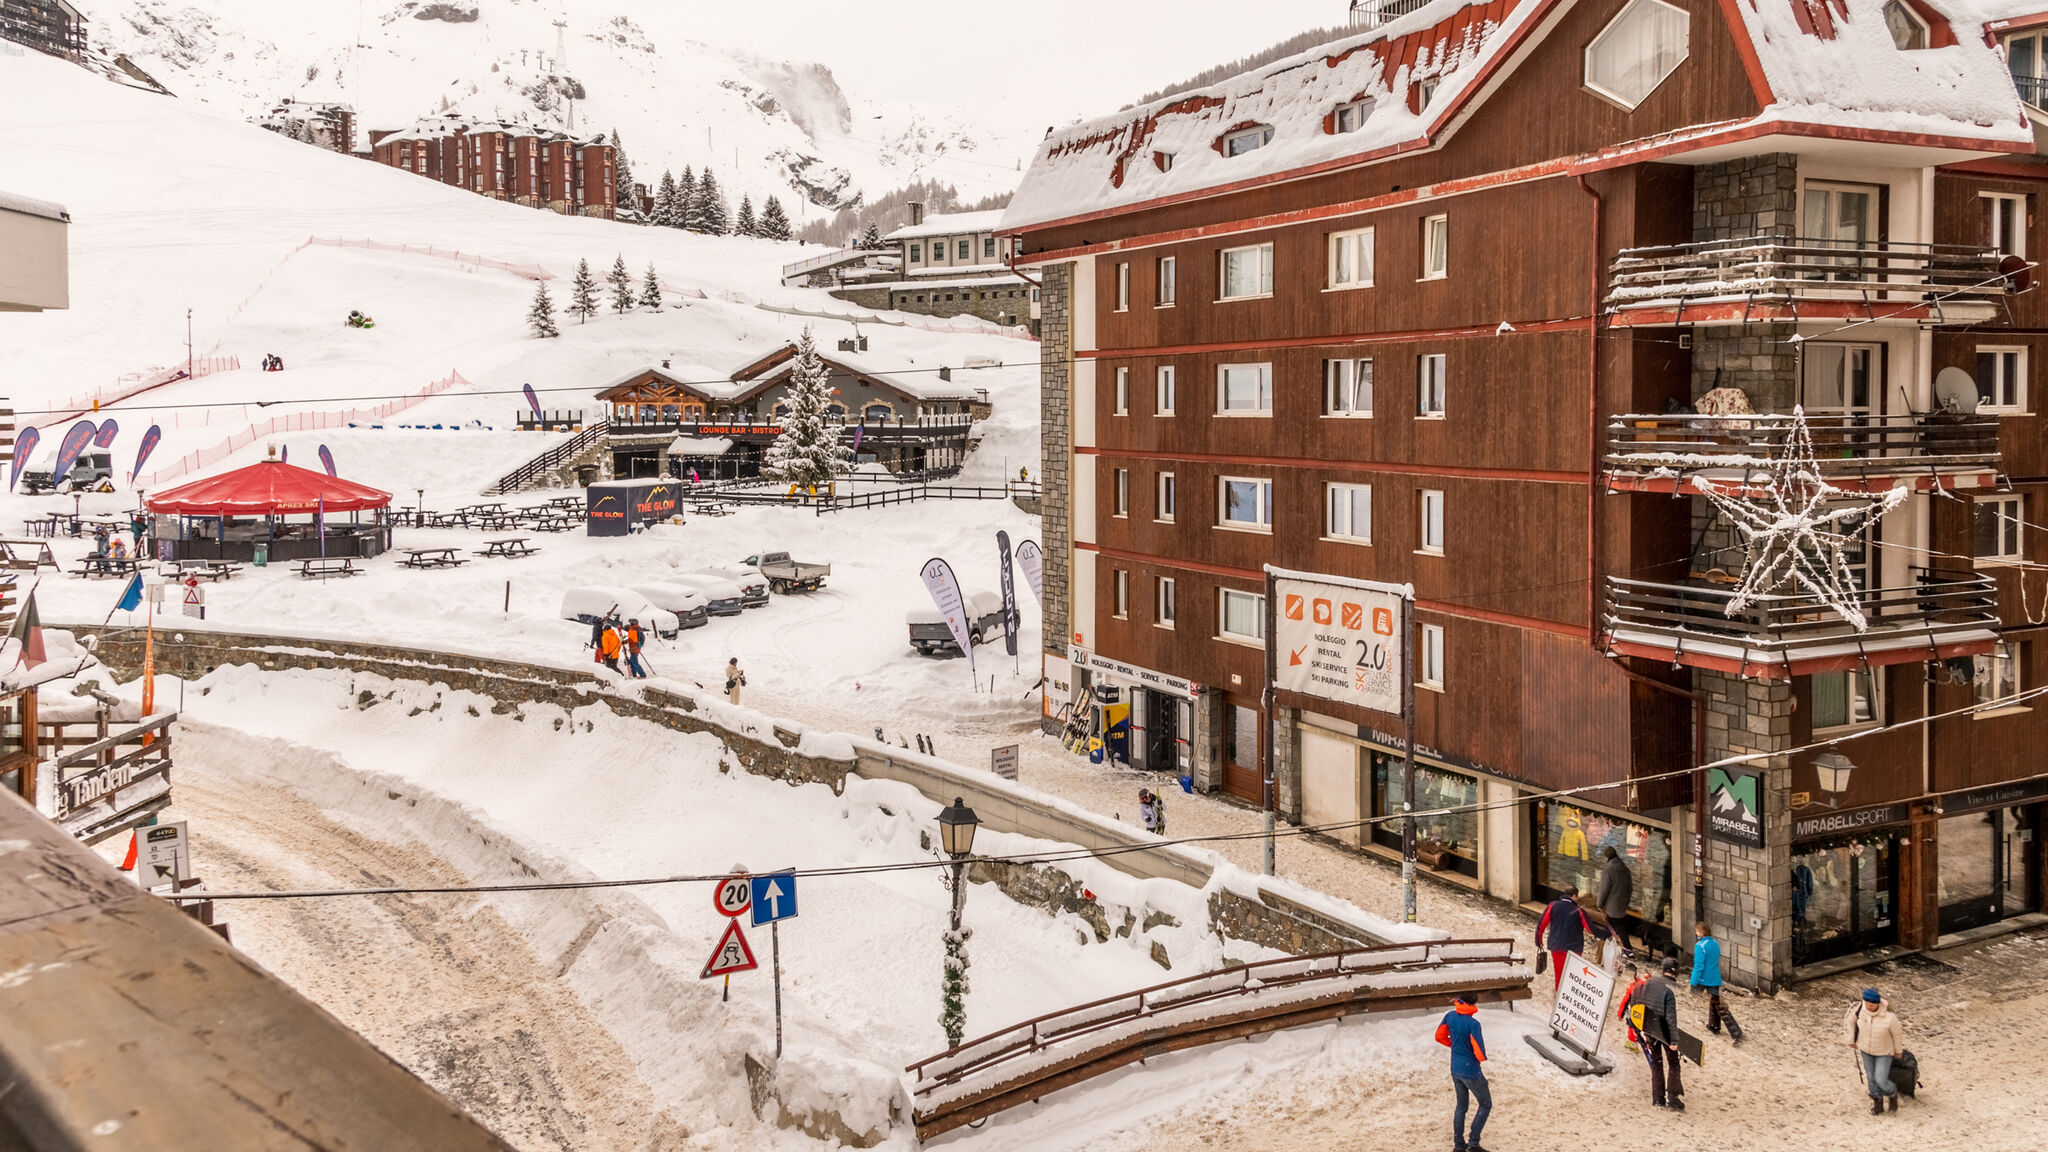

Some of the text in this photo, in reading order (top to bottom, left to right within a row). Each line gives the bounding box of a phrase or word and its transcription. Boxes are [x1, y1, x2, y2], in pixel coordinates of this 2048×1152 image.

[699, 426, 783, 435] LOUNGE BAR BISTROT
[637, 499, 675, 513] THE GLOW
[1314, 633, 1347, 646] NOLEGGIO
[1317, 647, 1342, 659] RENTAL
[1356, 639, 1386, 671] 2.0
[1091, 657, 1114, 671] NOLEGGIO
[1116, 664, 1134, 677] RENTAL
[1140, 671, 1160, 683] SERVICE
[1166, 678, 1188, 690] PARKING
[1311, 660, 1348, 674] SKI SERVICE
[1311, 673, 1349, 689] SKI PARKING
[1355, 667, 1366, 692] SKI
[1372, 730, 1443, 759] MIRAELL
[65, 762, 133, 808] Tandem
[1967, 789, 2025, 805] Vins et Cuisine
[1712, 815, 1759, 835] MIRABELL
[1712, 824, 1731, 834] SPORT
[725, 884, 748, 905] 20
[1569, 972, 1604, 998] NOLEGGIO
[1571, 985, 1596, 1006] RENTAL
[1561, 992, 1600, 1021] SKI SERVICE
[1557, 1002, 1598, 1033] SKI PARKING
